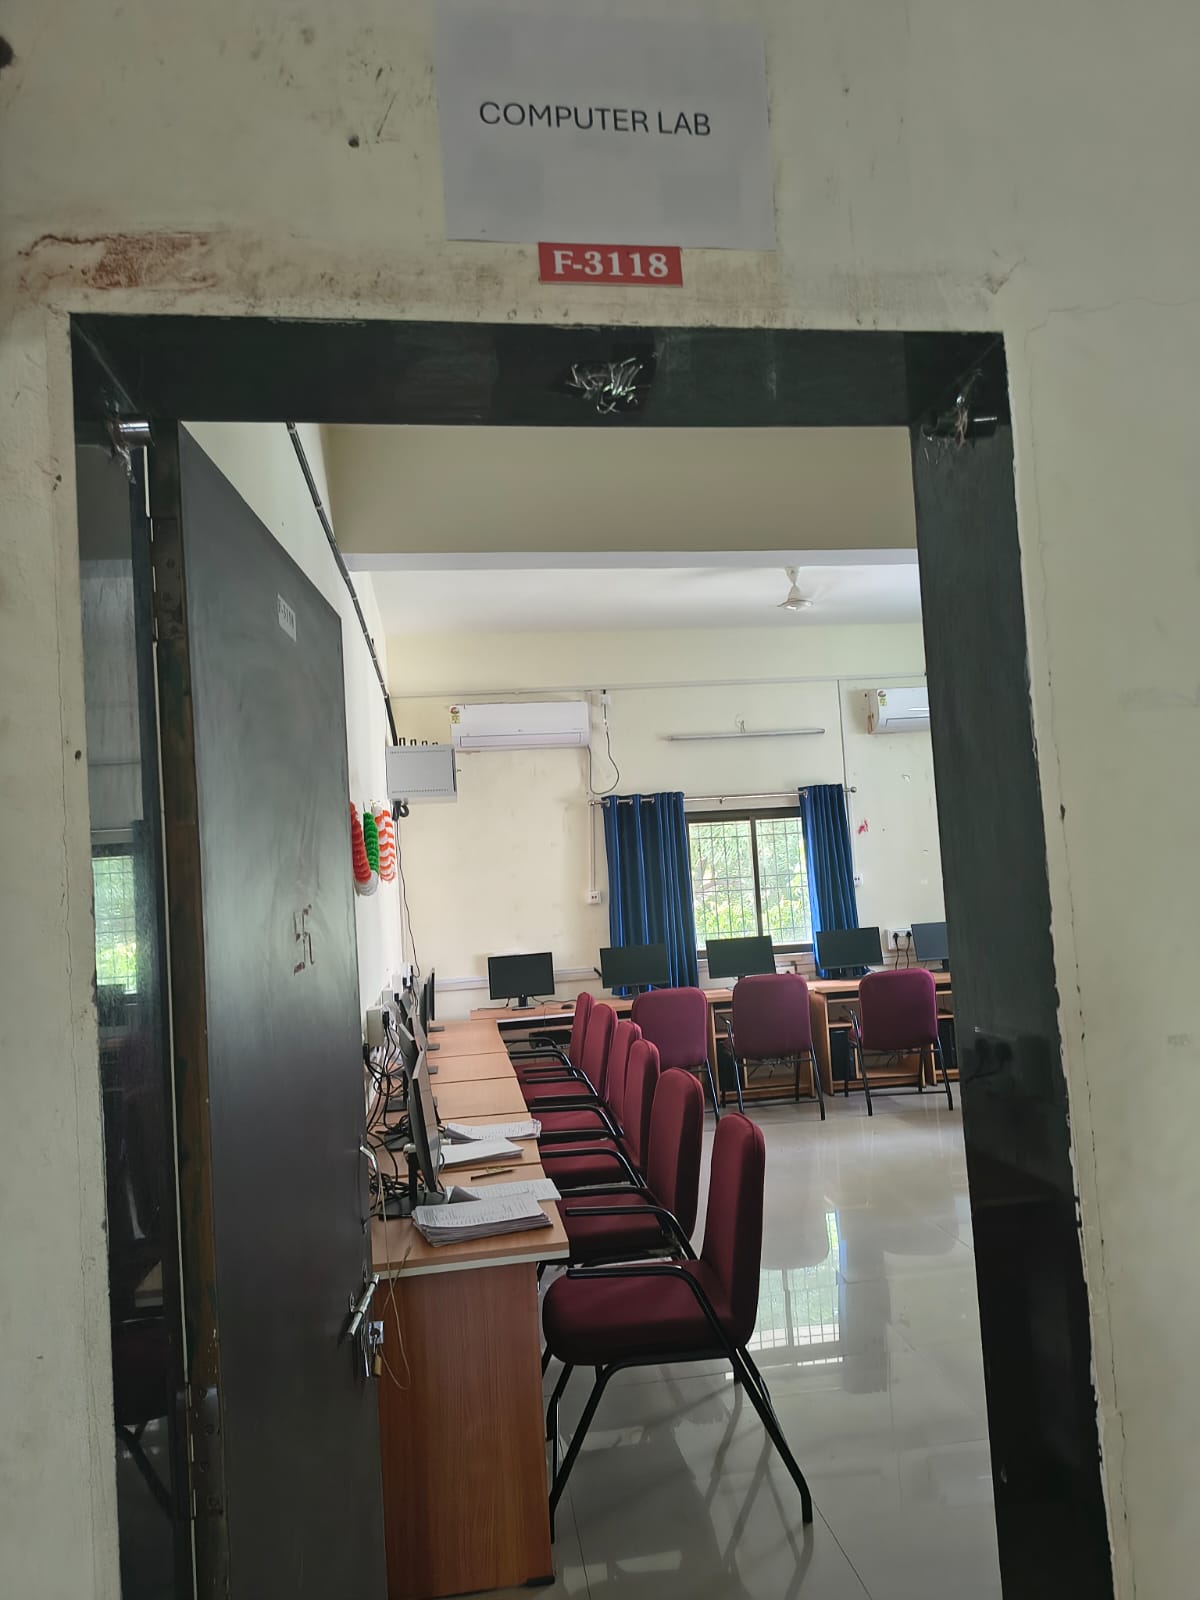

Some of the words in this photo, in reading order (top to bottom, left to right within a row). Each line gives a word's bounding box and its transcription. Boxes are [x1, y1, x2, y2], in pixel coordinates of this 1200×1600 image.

[479, 101, 649, 133] COMPUTER
[657, 111, 711, 136] LAB
[553, 250, 669, 278] F-3118
